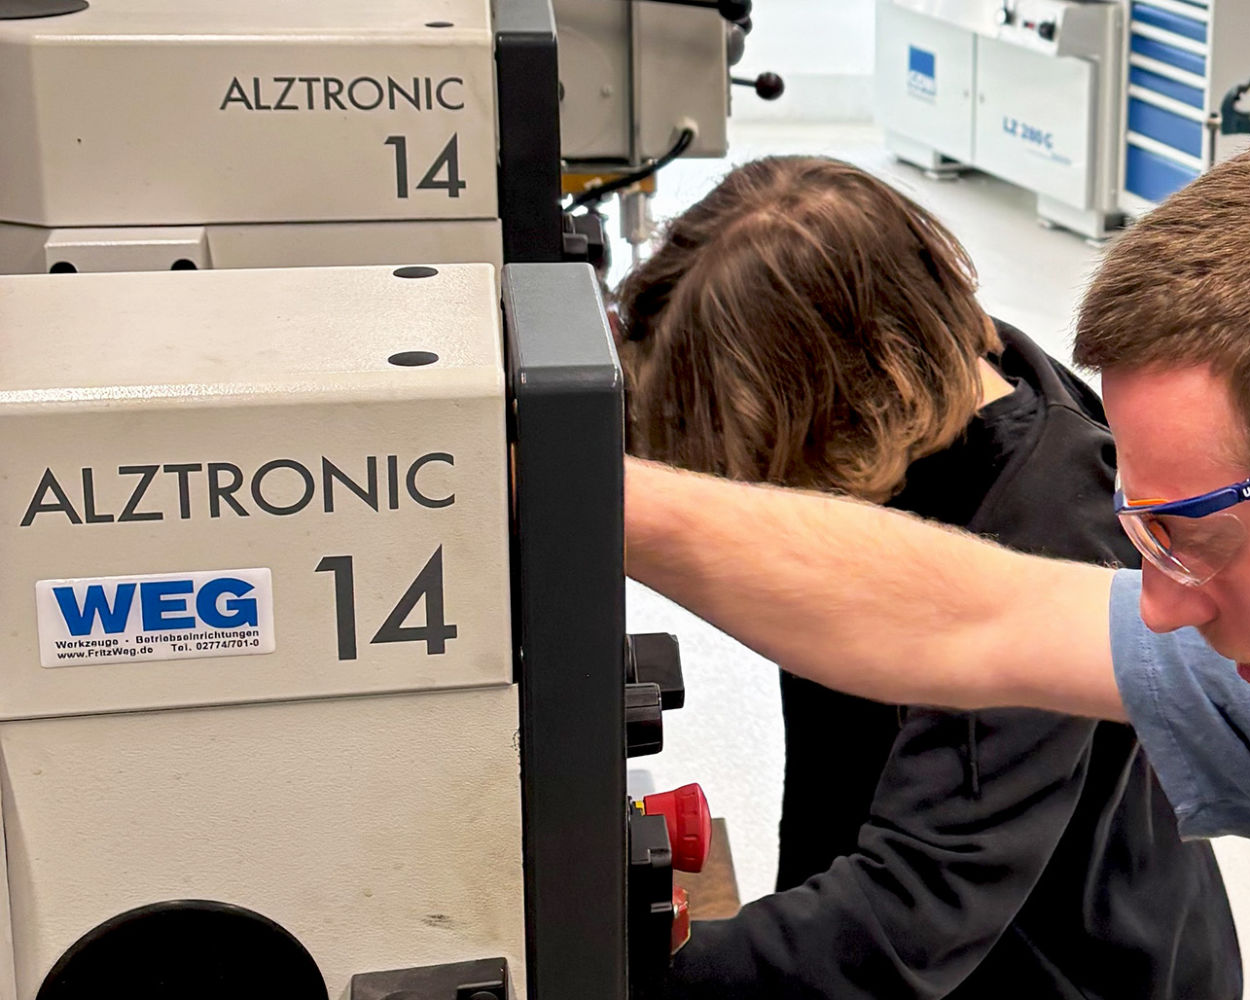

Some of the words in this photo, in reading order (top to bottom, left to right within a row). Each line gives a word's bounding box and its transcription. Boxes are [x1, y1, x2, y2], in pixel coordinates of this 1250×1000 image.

[219, 76, 465, 112] ALZTRONIC
[384, 131, 466, 199] 14
[20, 452, 456, 527] ALZTRONIC
[51, 577, 259, 637] WEG
[314, 543, 457, 661] 14
[55, 638, 119, 650] Werkzeuge
[136, 629, 260, 645] Betriebseinrichtungen
[57, 645, 154, 660] www.FritzWeg.de
[171, 643, 193, 653] Tel.
[196, 638, 260, 651] 02774/701-0
